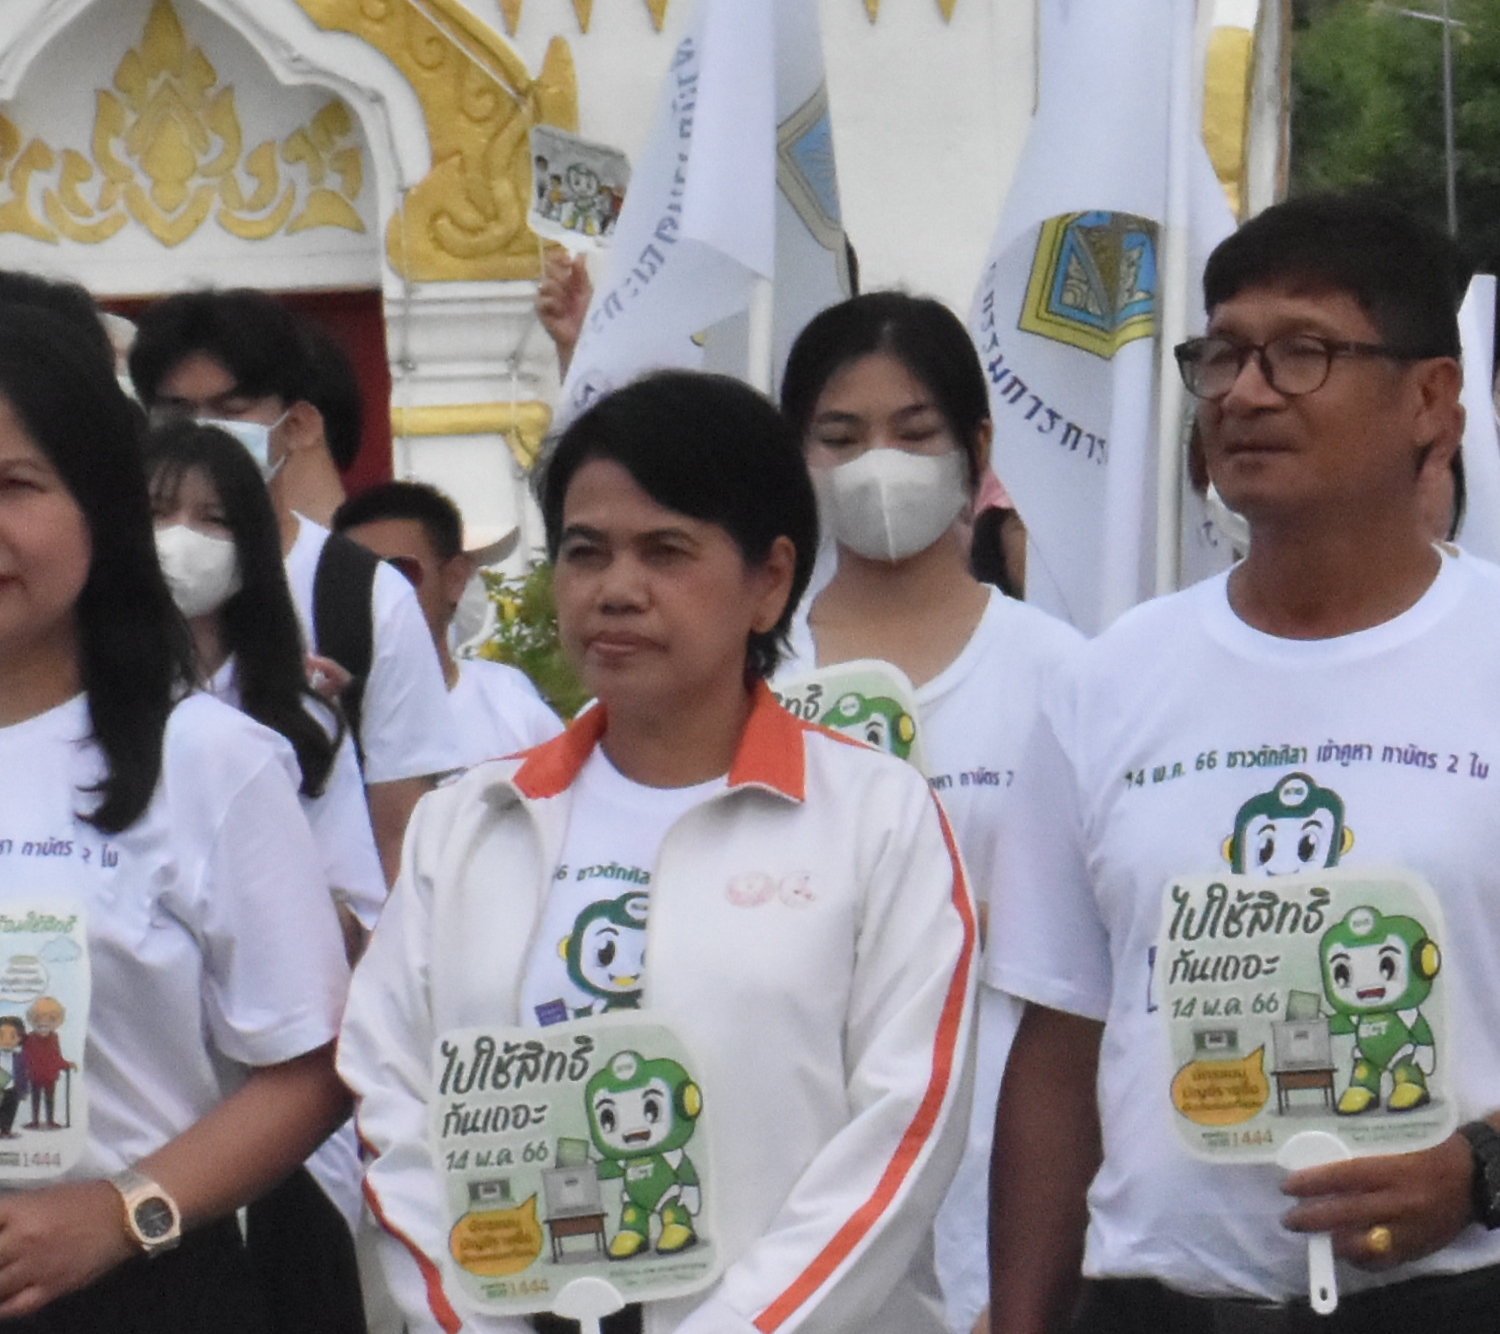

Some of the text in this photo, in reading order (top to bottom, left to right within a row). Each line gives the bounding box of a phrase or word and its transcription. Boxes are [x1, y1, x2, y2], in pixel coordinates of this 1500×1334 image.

[1124, 770, 1146, 791] 14
[1194, 749, 1218, 772] 66
[1226, 743, 1308, 771] ชาวตักศิลา
[1316, 739, 1373, 767] เข้าคูหา
[1380, 742, 1438, 771] กาบัตร
[1447, 753, 1460, 774] 2
[1469, 751, 1490, 781] ใบ
[1168, 882, 1331, 942] ไปใช้สิทธิ
[1170, 997, 1196, 1020] 14
[1251, 991, 1280, 1015] 66
[438, 1033, 595, 1097] ไปใช้สิทธิ
[444, 1148, 470, 1174] 14
[521, 1140, 550, 1163] 66
[1231, 1129, 1276, 1149] 1444
